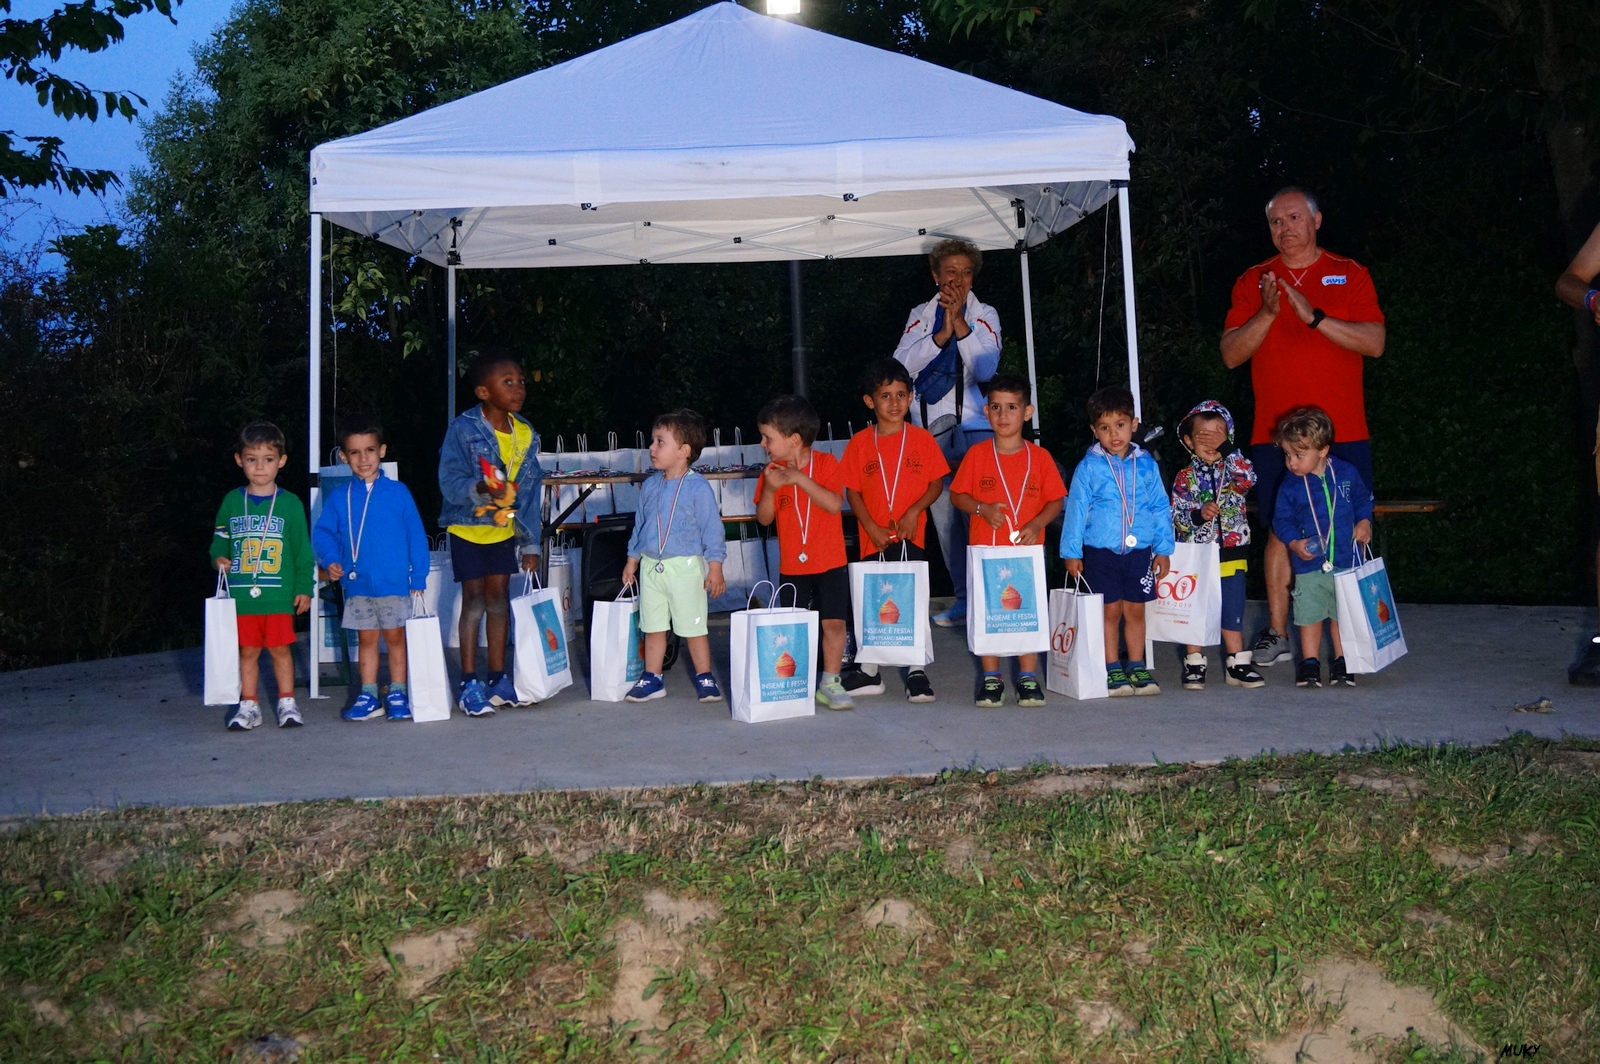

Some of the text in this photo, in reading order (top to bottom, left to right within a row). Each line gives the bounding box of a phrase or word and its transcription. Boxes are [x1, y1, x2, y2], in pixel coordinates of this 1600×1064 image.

[1325, 277, 1346, 285] AVIS
[230, 515, 285, 534] CHICAGO
[240, 538, 283, 574] 23
[1155, 569, 1197, 602] 60
[1052, 622, 1075, 654] 60
[761, 682, 785, 690] INSIEME
